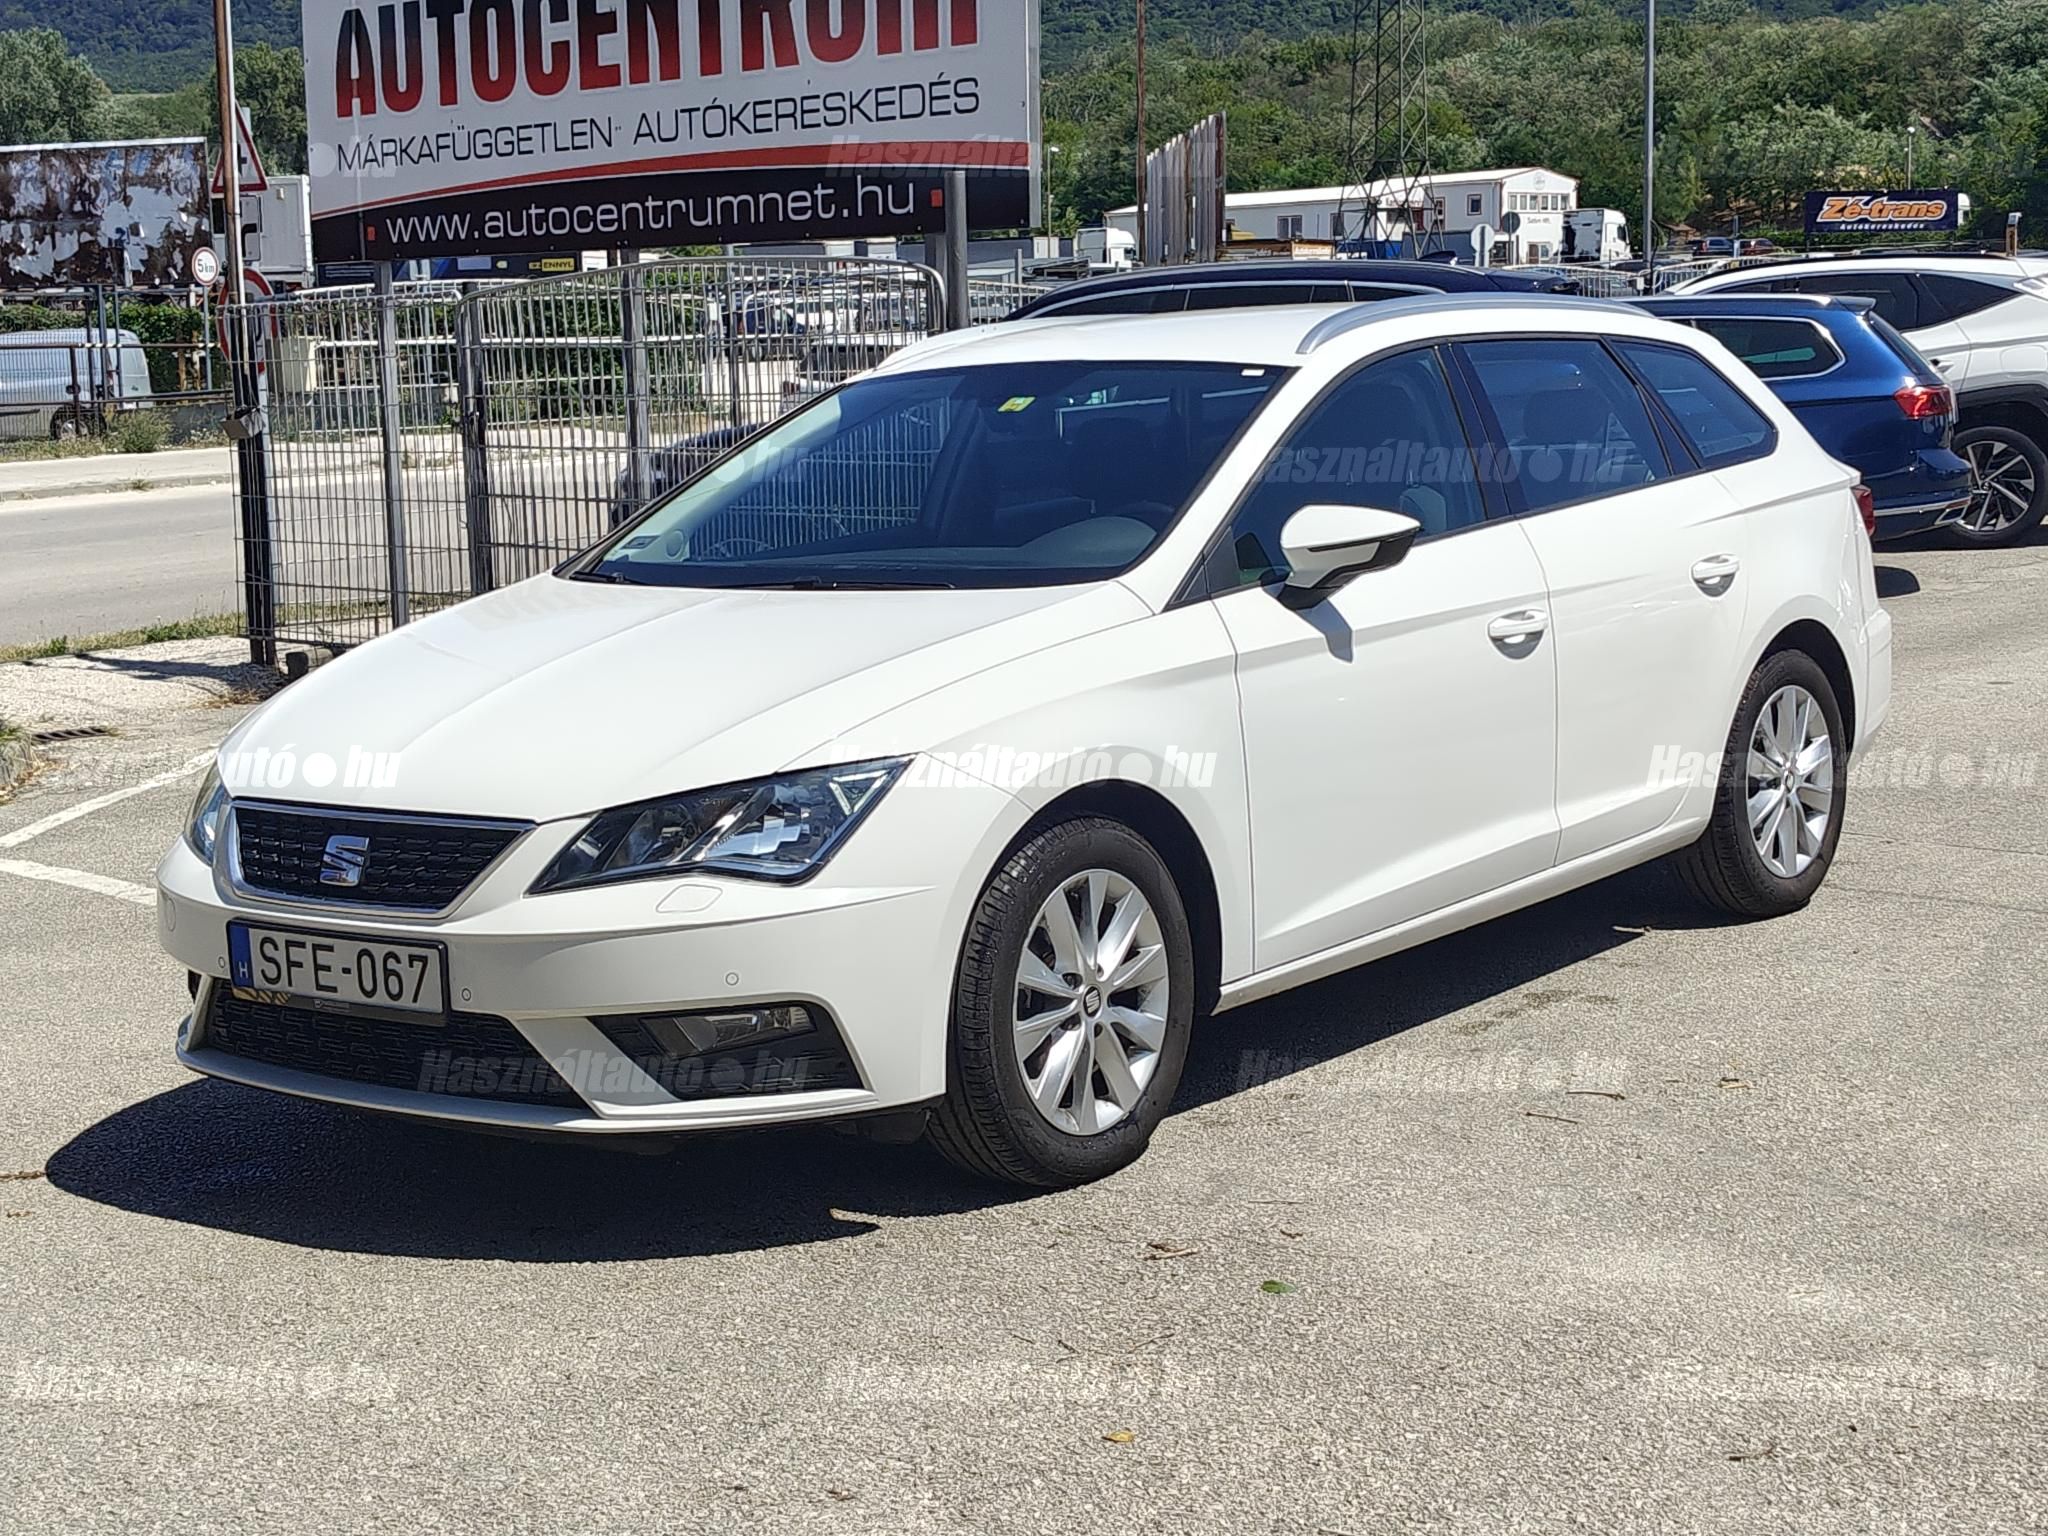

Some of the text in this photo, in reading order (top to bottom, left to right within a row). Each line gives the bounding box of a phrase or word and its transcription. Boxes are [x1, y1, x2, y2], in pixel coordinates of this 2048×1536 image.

[337, 72, 980, 172] MÁRKAFÜGGETLEN AUTÓKERESKEDÉS
[386, 175, 914, 243] www.autocentrumnet.hu
[1818, 196, 1946, 222] Zé-trans
[238, 936, 429, 1004] H SFE-067
